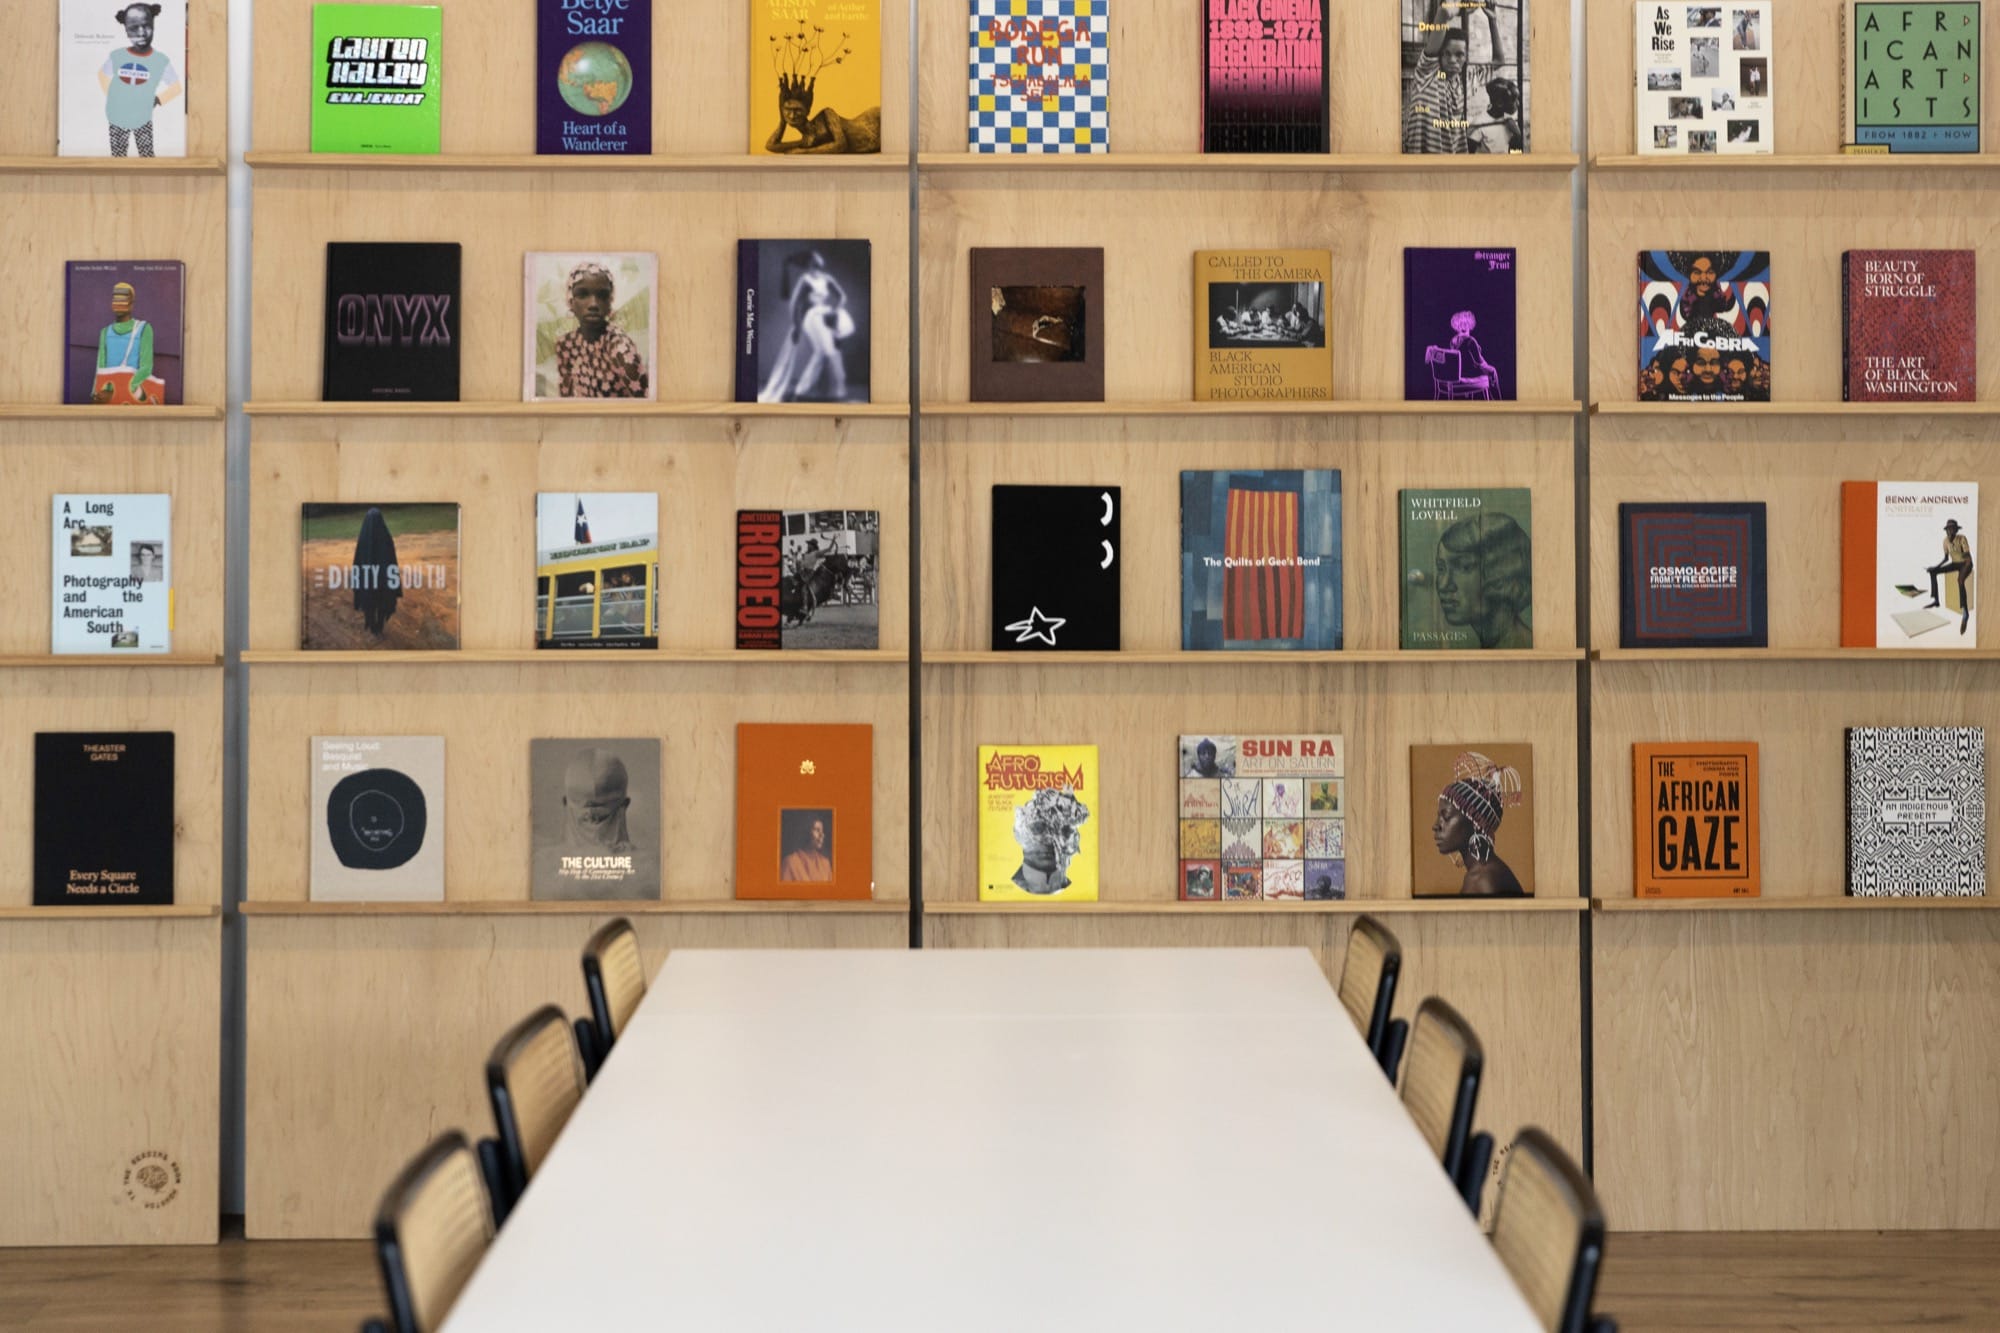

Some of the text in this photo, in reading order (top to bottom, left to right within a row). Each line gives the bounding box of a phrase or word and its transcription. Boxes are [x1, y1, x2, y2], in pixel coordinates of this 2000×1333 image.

[1210, 0, 1322, 20] BLACK CINEMA
[1656, 6, 1670, 20] As
[567, 16, 624, 35] Saar
[988, 20, 1091, 42] BODEGA
[1419, 22, 1450, 31] Dream
[1654, 22, 1672, 36] We
[1652, 37, 1675, 51] Rise
[1017, 46, 1062, 66] RUN
[1209, 40, 1322, 68] REGENERATION
[1020, 88, 1056, 102] SELF
[1415, 104, 1430, 112] the
[562, 121, 627, 136] Heart of a
[1433, 120, 1470, 130] Rhythm
[1864, 131, 1972, 140] FROM 1882 NOW
[562, 138, 628, 152] Wanderer
[1208, 256, 1284, 268] CALLED TO
[1865, 260, 1918, 272] BEAUTY
[1234, 268, 1322, 280] THE CAMERA
[1865, 273, 1926, 284] BORN OF
[1864, 286, 1936, 297] STRUGGLE
[338, 294, 451, 343] ONYX
[1210, 352, 1252, 362] BLACK
[1865, 356, 1925, 368] THE ART
[1210, 364, 1281, 375] AMERICAN
[1865, 369, 1930, 380] OF BLACK
[1234, 376, 1283, 386] STUDIO
[1210, 387, 1327, 399] PHOTOGRAPHERS
[1865, 382, 1958, 393] WASHINGTON
[1668, 393, 1698, 402] Messages
[1410, 498, 1482, 508] WHITFIELD
[1885, 495, 1969, 504] BENNY ANDREWS
[64, 501, 114, 516] A Long
[1411, 510, 1458, 521] LOVELL
[64, 517, 86, 529] Arc
[1204, 557, 1222, 566] The
[1224, 557, 1253, 567] Quilts
[1255, 557, 1266, 566] of
[1297, 557, 1320, 566] Bend
[328, 564, 380, 589] DIRTY
[386, 564, 446, 589] SOUTH
[738, 524, 780, 627] RODEO
[1650, 566, 1737, 576] COSMOLOGIES
[64, 575, 144, 590] Photography
[1674, 576, 1705, 584] TREE
[1711, 576, 1736, 584] LIFE
[64, 591, 143, 602] and the
[64, 606, 124, 618] American
[87, 621, 124, 633] South
[1412, 630, 1468, 642] PASSAGES
[82, 744, 126, 752] THEASTER
[1242, 740, 1335, 758] SUN RA
[986, 750, 1040, 772] AFRO
[1242, 758, 1335, 769] ART ON SATURN
[1658, 762, 1675, 777] THE
[984, 764, 1084, 790] FUTURISM
[1658, 780, 1740, 812] AFRICAN
[1897, 812, 1936, 820] PRESENT
[1658, 816, 1740, 871] GAZE
[562, 857, 632, 868] THE CULTURE
[68, 870, 136, 882] Every Square
[66, 884, 98, 894] Needs
[108, 884, 140, 894] Circle
